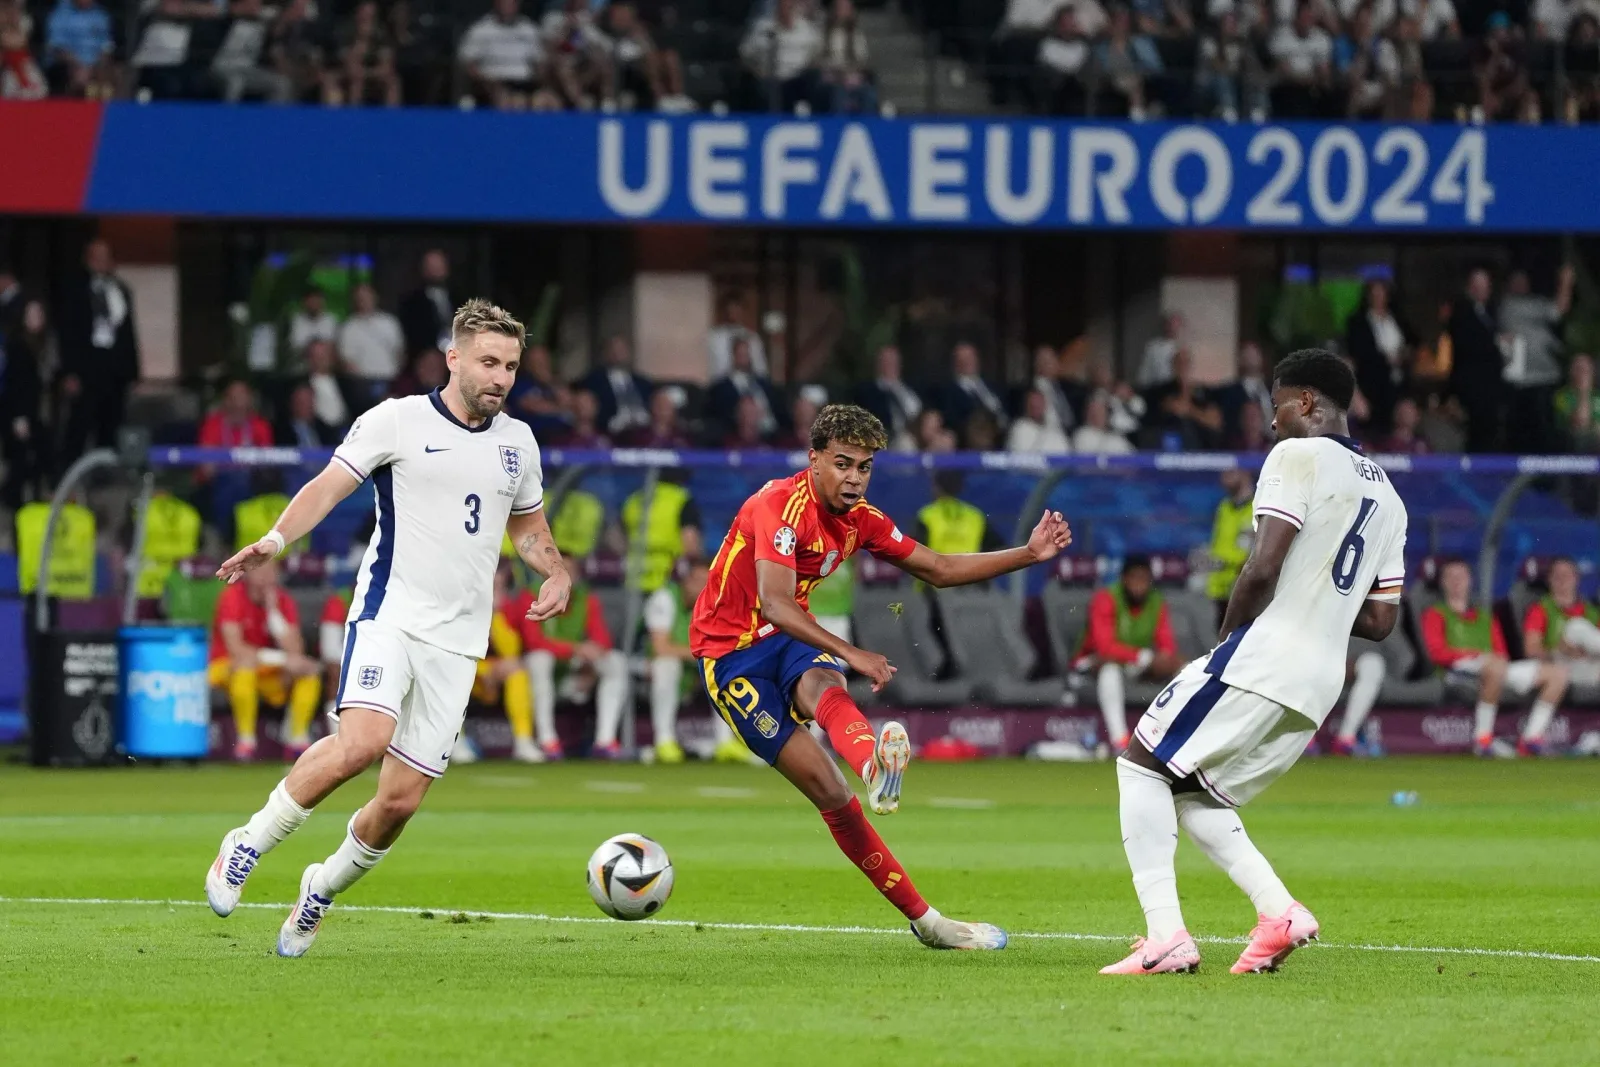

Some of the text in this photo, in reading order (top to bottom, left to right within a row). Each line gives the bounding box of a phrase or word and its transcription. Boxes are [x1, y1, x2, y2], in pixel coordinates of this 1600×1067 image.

[599, 120, 1494, 224] UEFA EURO 2024
[464, 493, 482, 536] 3
[1332, 496, 1378, 596] 6
[720, 677, 759, 720] 19
[1155, 680, 1184, 710] 6
